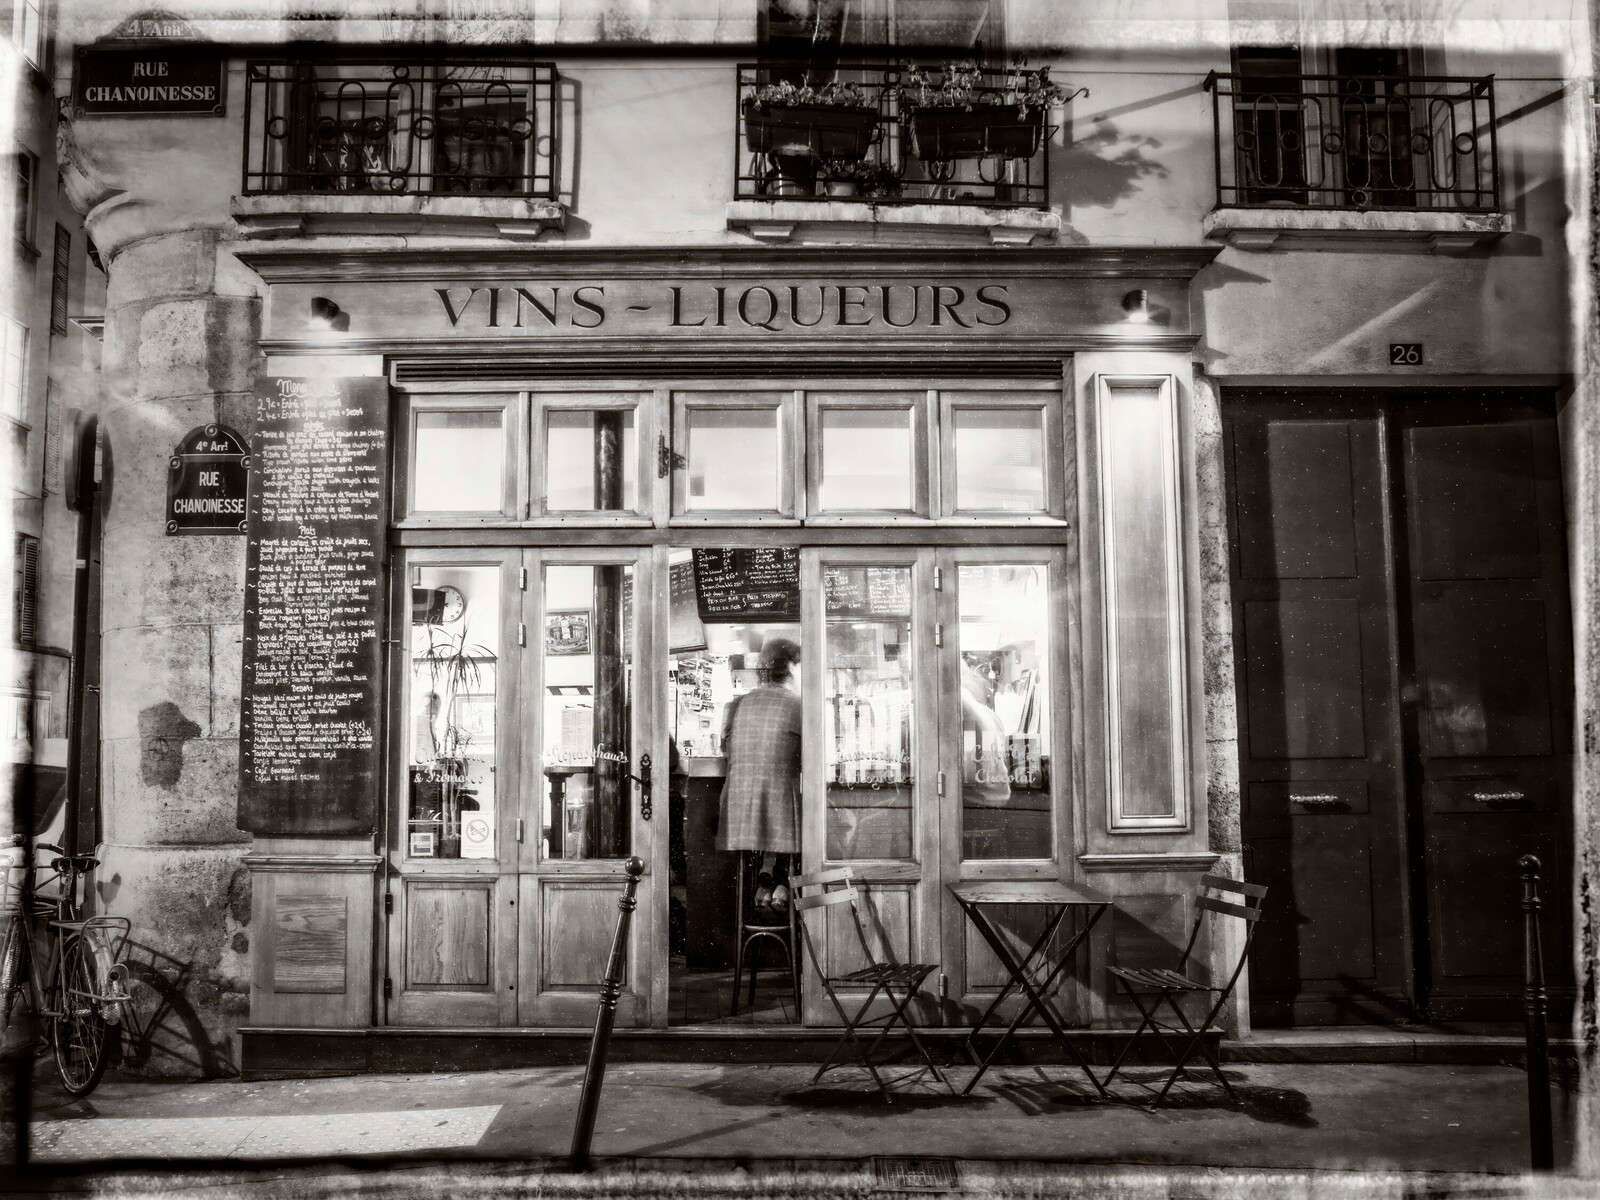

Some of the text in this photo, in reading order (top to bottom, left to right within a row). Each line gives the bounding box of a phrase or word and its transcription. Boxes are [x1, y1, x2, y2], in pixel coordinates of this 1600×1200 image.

[133, 61, 169, 77] RUE
[85, 86, 216, 102] CHANOINESSE
[433, 286, 606, 328] VINS
[668, 284, 1012, 332] LIQUEURS
[1393, 345, 1419, 363] 26
[199, 471, 220, 486] RUE
[173, 499, 245, 513] CHANOINESSE
